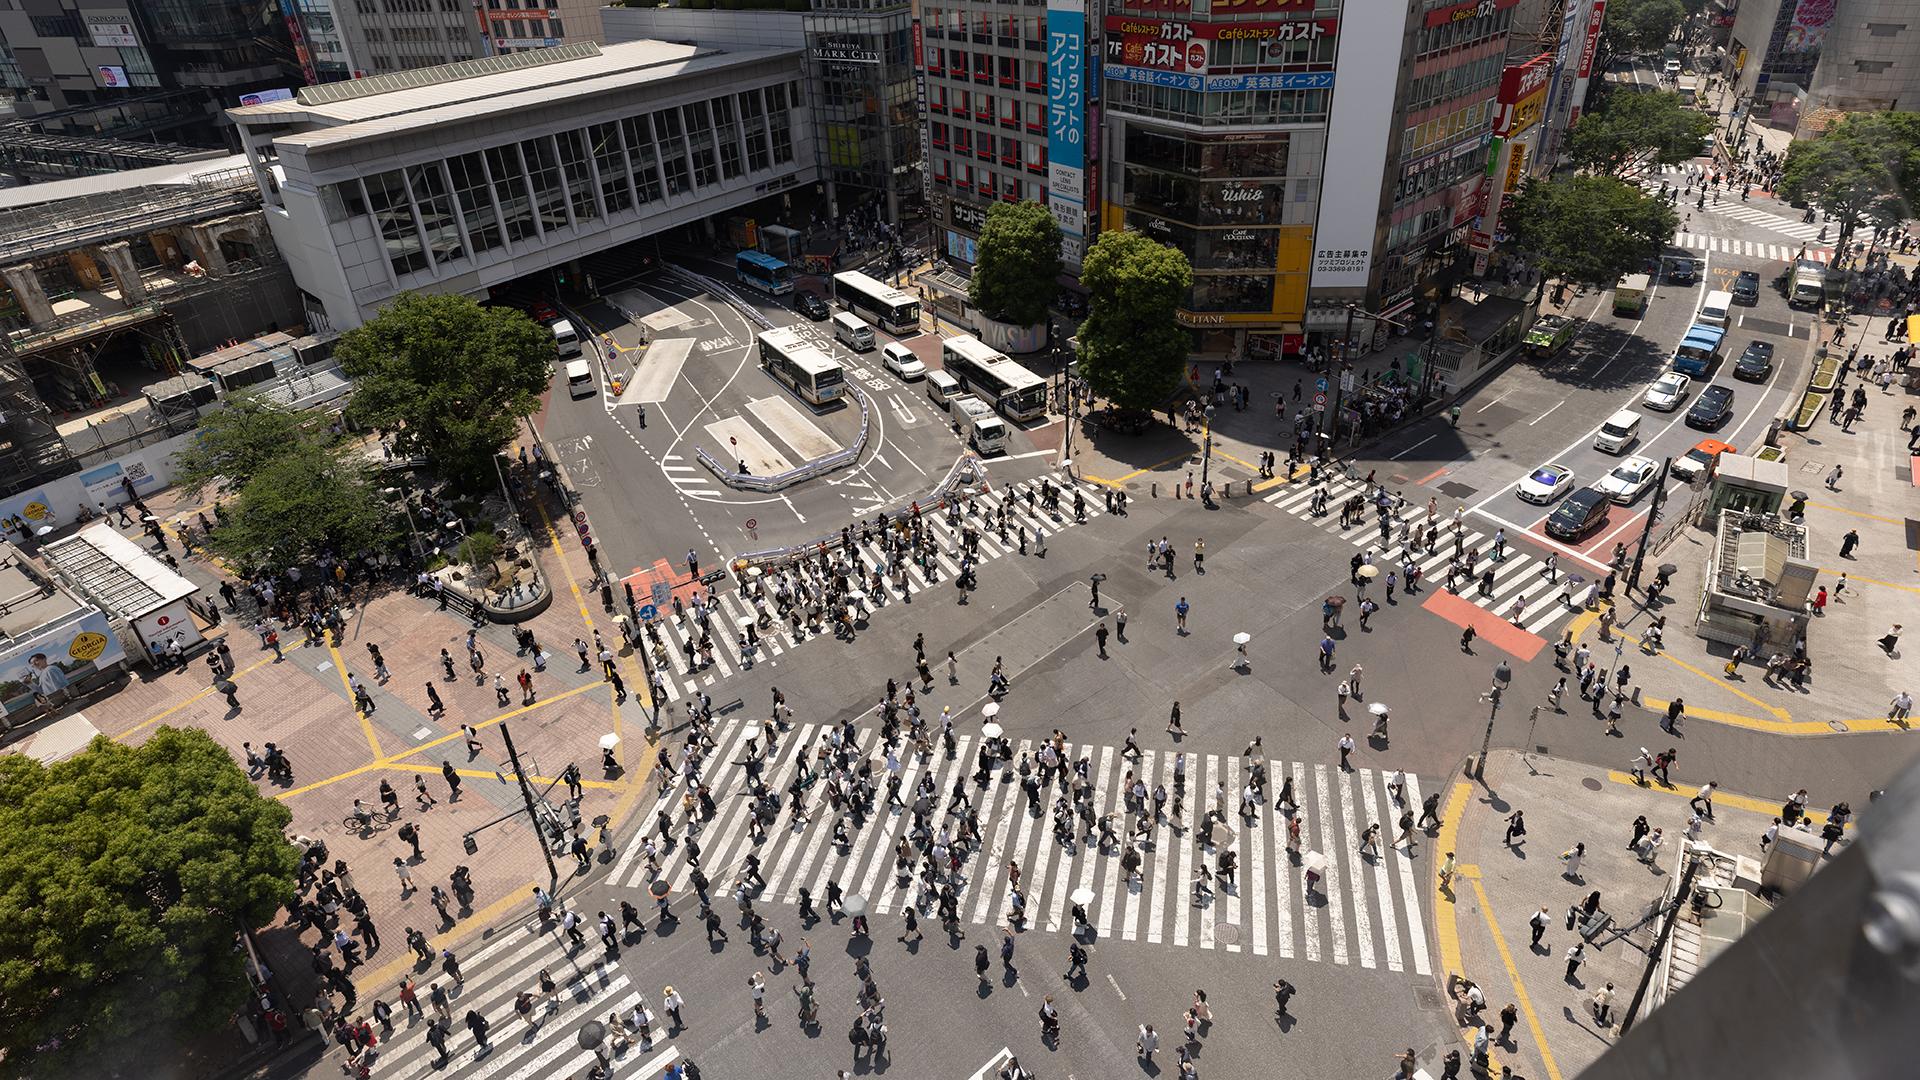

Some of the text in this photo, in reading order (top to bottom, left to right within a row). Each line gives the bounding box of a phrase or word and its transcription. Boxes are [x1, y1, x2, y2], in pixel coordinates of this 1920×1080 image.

[1160, 22, 1194, 41] ガスト
[1218, 22, 1325, 41] Caféレストラン ガスト
[813, 48, 880, 60] MARK CITY
[827, 42, 861, 50] SHIBUYA
[1108, 41, 1122, 55] 7F
[1143, 42, 1183, 67] ガスト
[1581, 32, 1598, 71] TaxFree
[1052, 32, 1067, 142] アイシティ
[1129, 69, 1186, 87] 英会話イーオン
[1211, 78, 1239, 88] AEON
[1245, 75, 1331, 89] 英会話イーオン
[1068, 33, 1080, 145] コンタクトの
[1055, 168, 1076, 179] CONTACT
[1221, 188, 1264, 201] Ushi8
[1444, 224, 1469, 249] LUSH
[1318, 250, 1368, 258] 広告主募集中
[71, 637, 105, 656] GEORGIA
